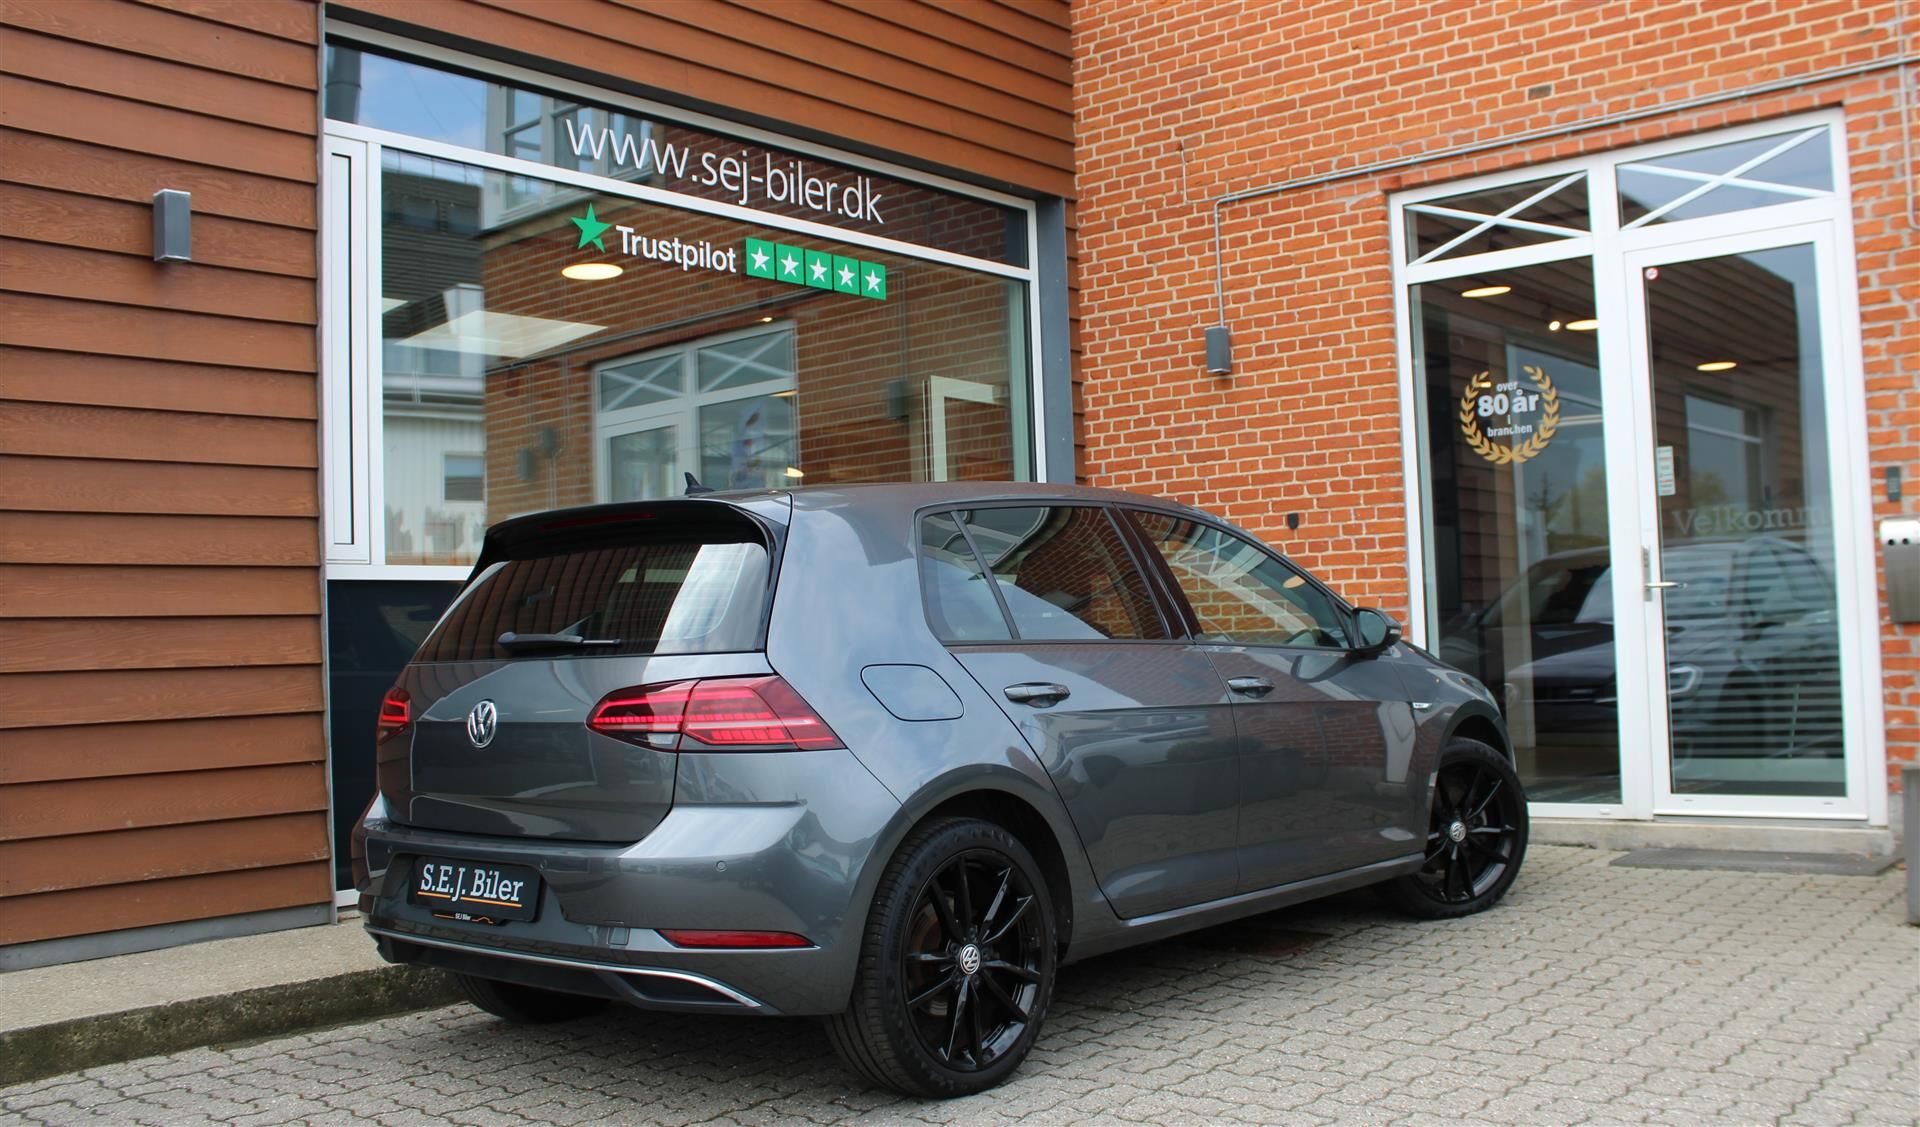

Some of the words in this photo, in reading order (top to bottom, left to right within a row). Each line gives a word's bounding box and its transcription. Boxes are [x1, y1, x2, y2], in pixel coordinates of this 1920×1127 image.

[565, 119, 884, 224] www.sej-biler.dk
[616, 225, 737, 273] Trustpilot
[1478, 394, 1509, 417] 80
[1513, 389, 1539, 413] år
[1497, 382, 1518, 392] over
[1487, 424, 1533, 437] branchen
[421, 864, 466, 902] S.E.J.
[471, 869, 523, 902] Biler
